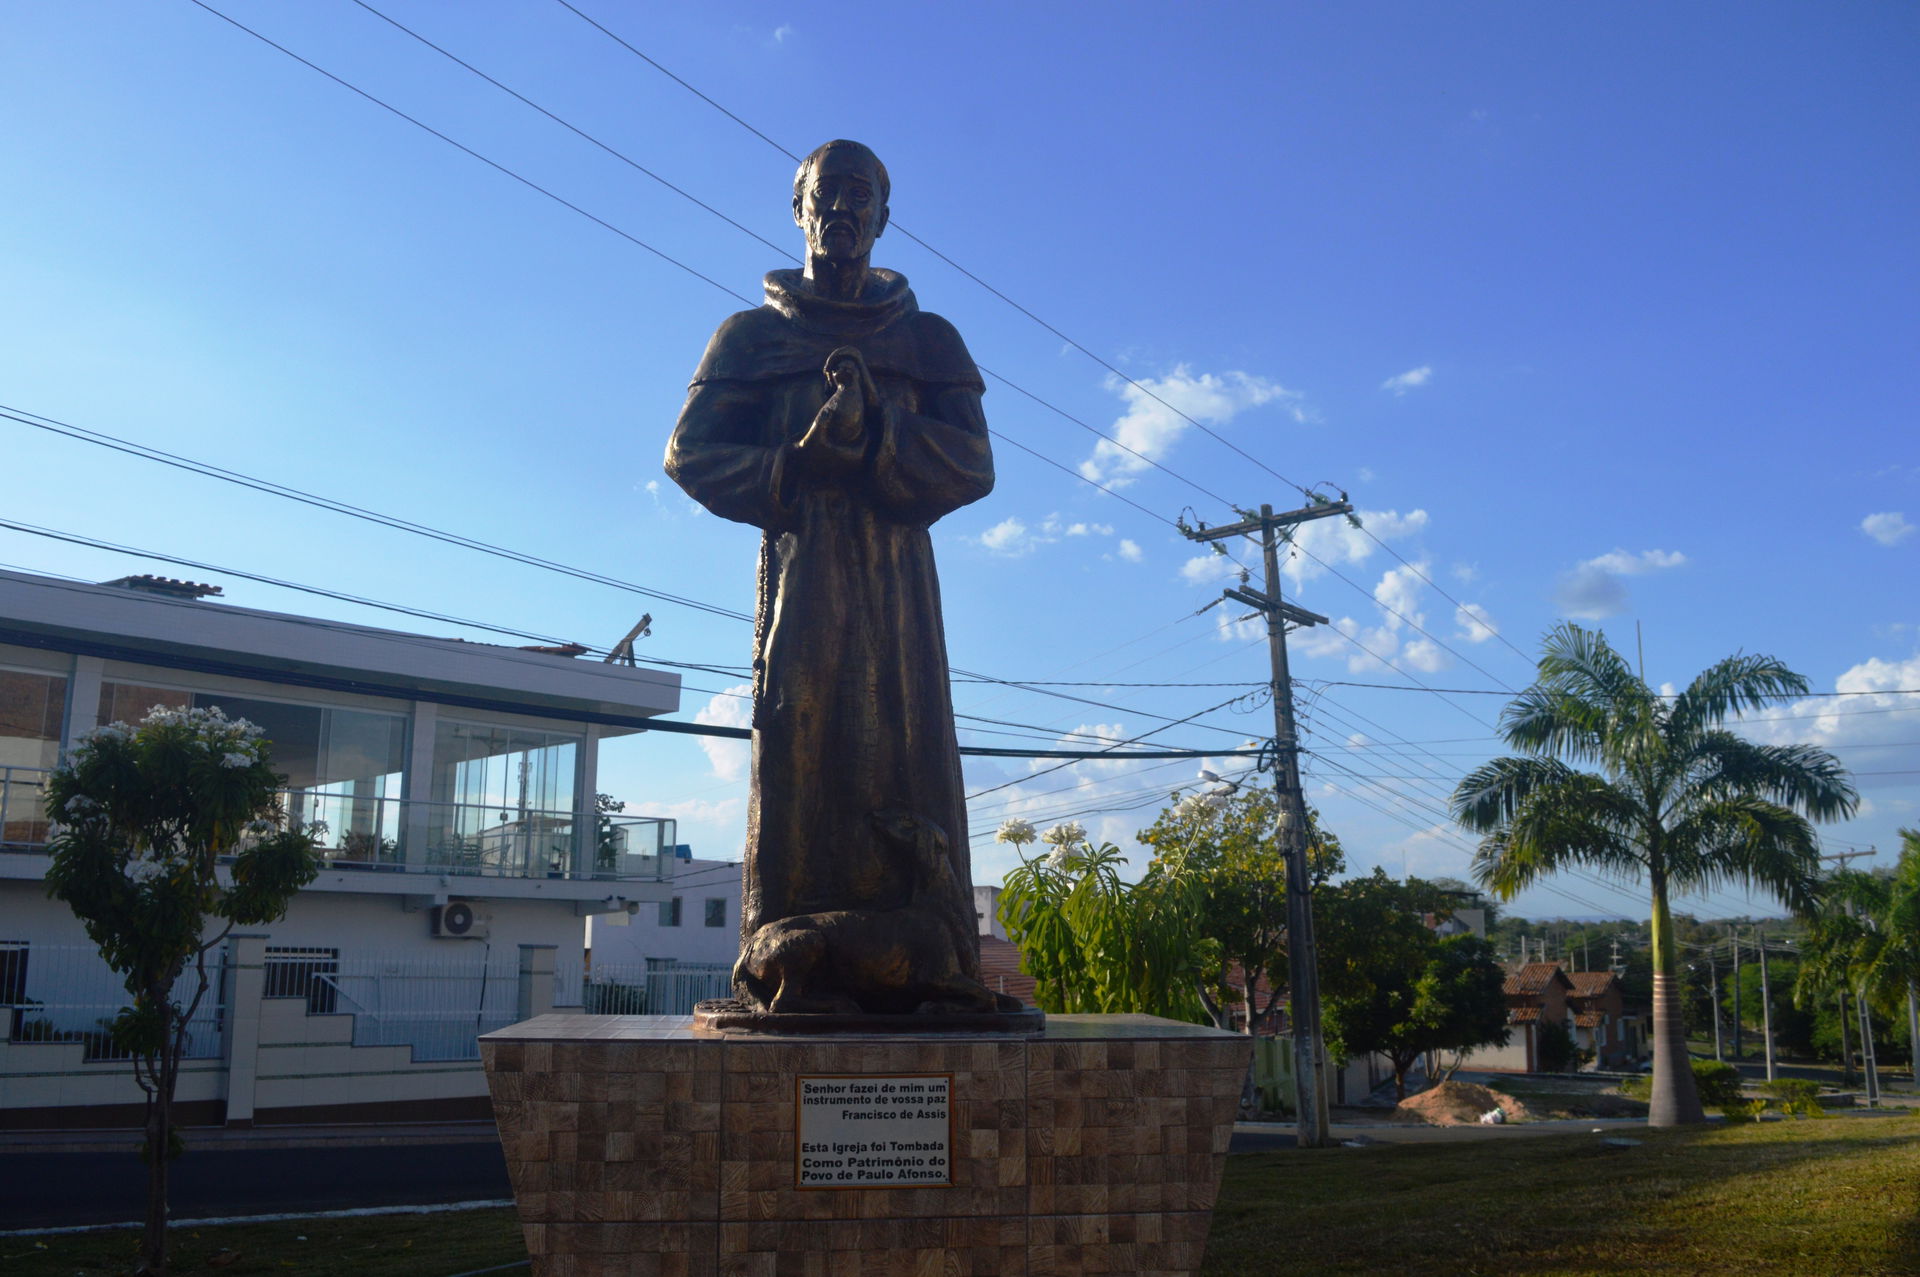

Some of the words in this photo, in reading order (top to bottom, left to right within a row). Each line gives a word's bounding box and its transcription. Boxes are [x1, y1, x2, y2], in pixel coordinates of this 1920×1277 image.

[804, 1083, 846, 1094] Senhor
[850, 1083, 877, 1093] fazei
[881, 1083, 896, 1093] de
[900, 1083, 924, 1093] mim
[928, 1084, 946, 1093] um
[803, 1095, 872, 1105] instrumento
[874, 1095, 889, 1104] de
[891, 1096, 924, 1104] vossa
[927, 1095, 946, 1106] paz
[842, 1110, 896, 1120] Francisco
[900, 1110, 913, 1119] de
[916, 1109, 946, 1119] Assis
[802, 1142, 829, 1153] Esta
[871, 1141, 886, 1151] foi
[889, 1141, 944, 1151] Tombada
[802, 1158, 843, 1168] Como
[848, 1156, 924, 1167] Patrimônio
[928, 1156, 946, 1166] do
[802, 1170, 833, 1181] Povo
[837, 1170, 853, 1180] de
[857, 1169, 894, 1179] Paulo
[897, 1169, 946, 1179] Afonso.
